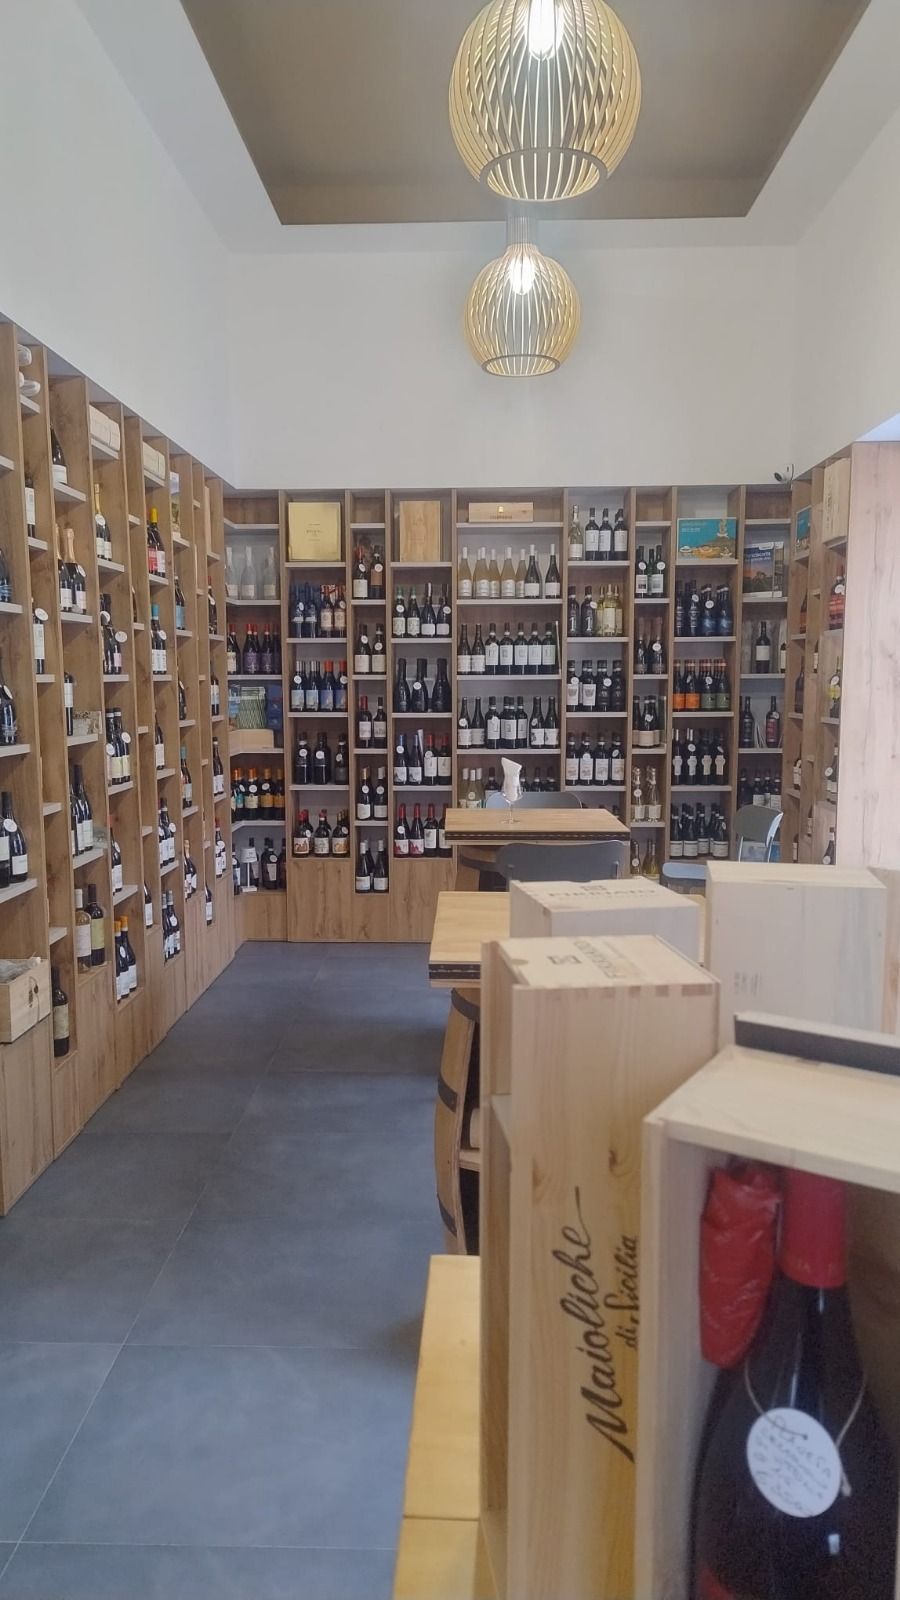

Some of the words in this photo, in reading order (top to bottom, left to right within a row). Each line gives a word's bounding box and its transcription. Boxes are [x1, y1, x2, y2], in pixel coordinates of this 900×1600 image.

[552, 1186, 636, 1465] Maioliche
[603, 1234, 640, 1326] Sicilia
[615, 1326, 639, 1351] di
